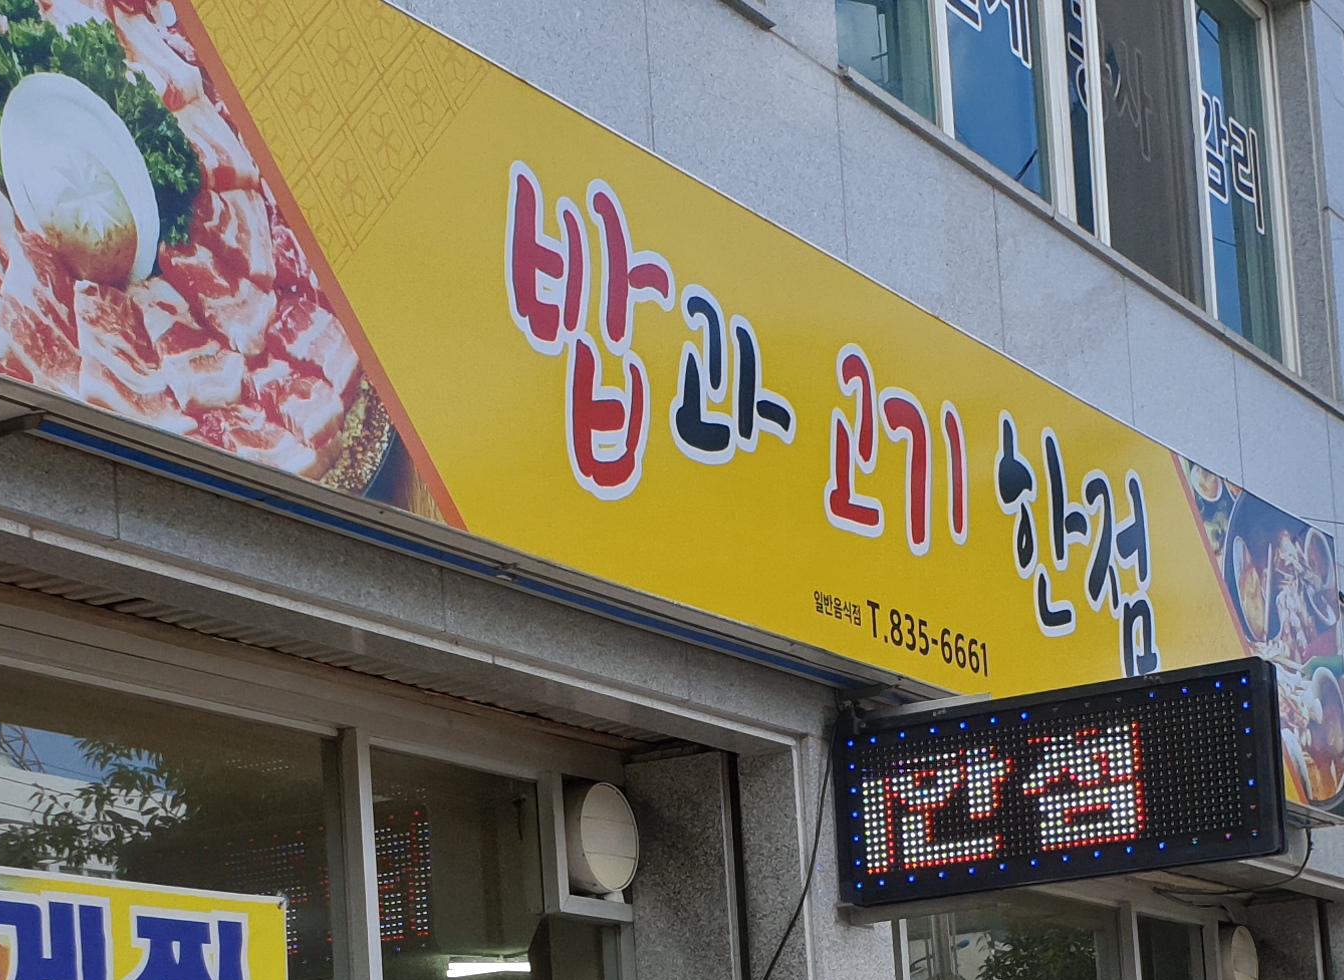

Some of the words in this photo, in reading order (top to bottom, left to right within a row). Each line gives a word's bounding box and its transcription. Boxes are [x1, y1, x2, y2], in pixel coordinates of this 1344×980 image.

[506, 160, 796, 499] 밥과
[825, 344, 967, 556] 고기
[995, 410, 1162, 677] 한점
[813, 590, 862, 626] 일반음식점
[867, 599, 989, 678] T.835-6661
